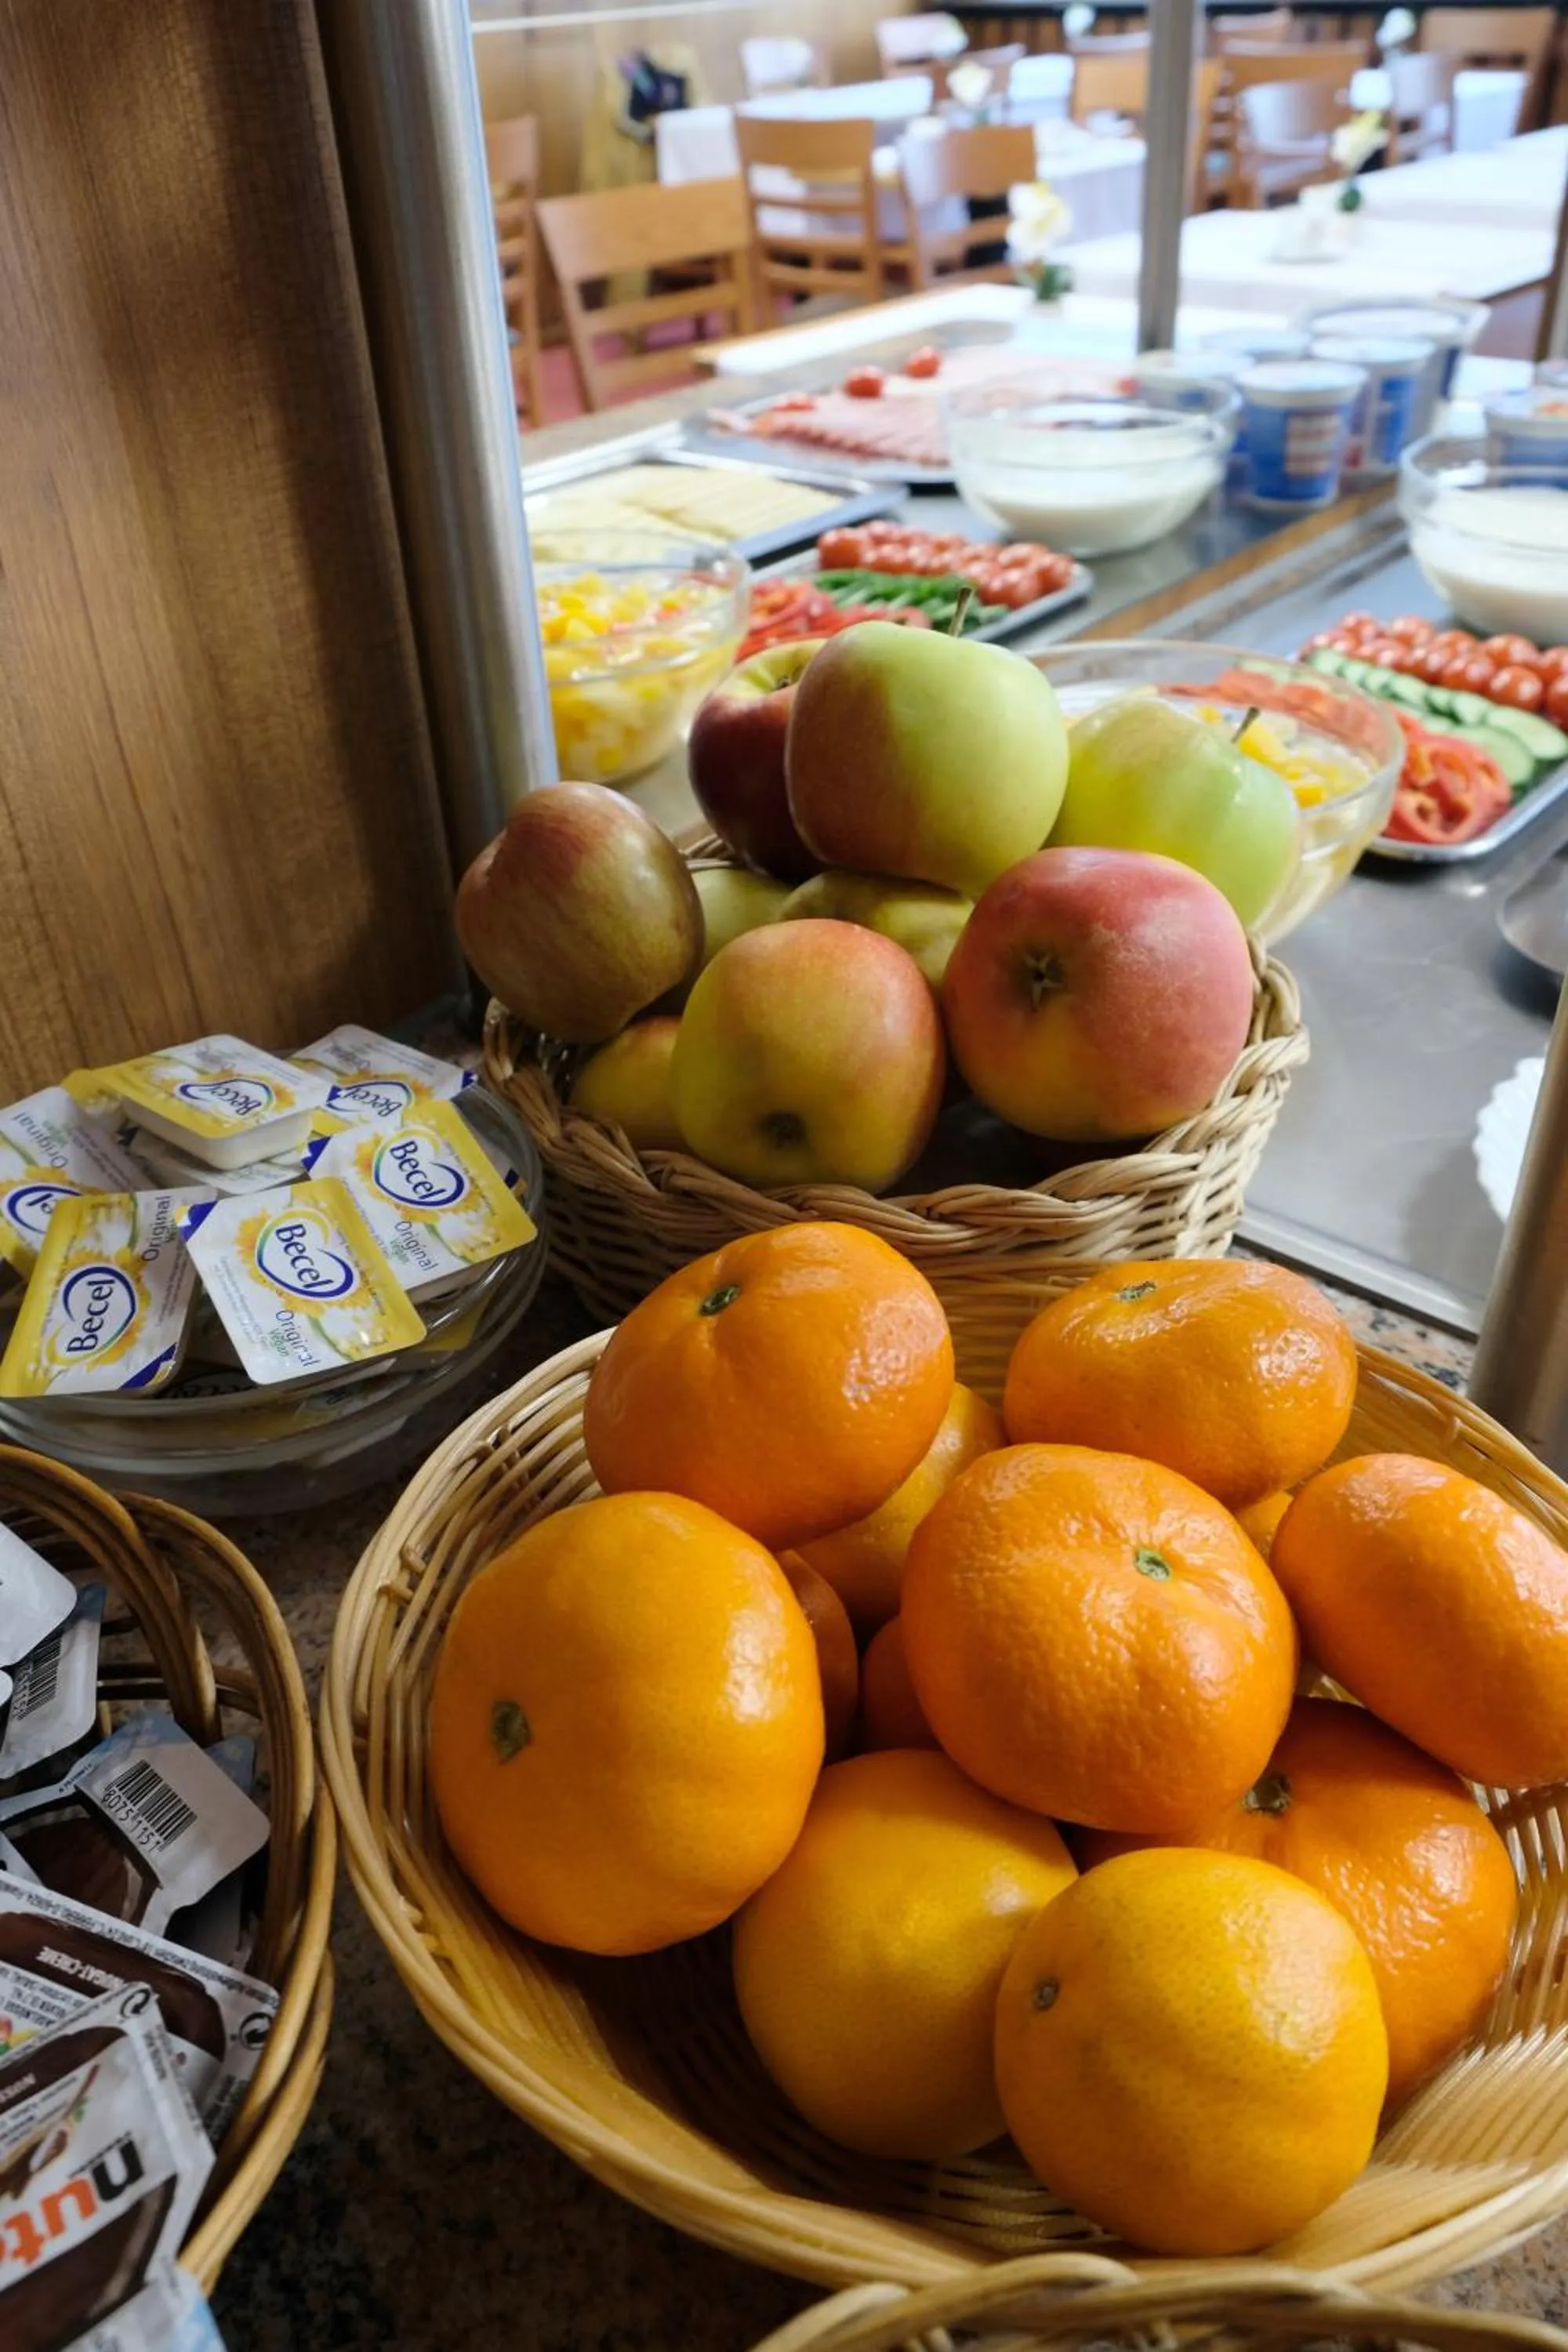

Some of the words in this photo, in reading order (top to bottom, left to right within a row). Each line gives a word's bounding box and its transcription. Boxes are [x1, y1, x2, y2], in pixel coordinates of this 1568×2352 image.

[343, 1087, 403, 1117] Becel
[389, 1140, 448, 1200] Becel
[142, 1196, 171, 1262] Original
[275, 1223, 335, 1290] Becel
[394, 1220, 439, 1272] Original
[66, 1279, 115, 1353] Becel
[275, 1308, 321, 1367] Original
[0, 2140, 144, 2267] nut
